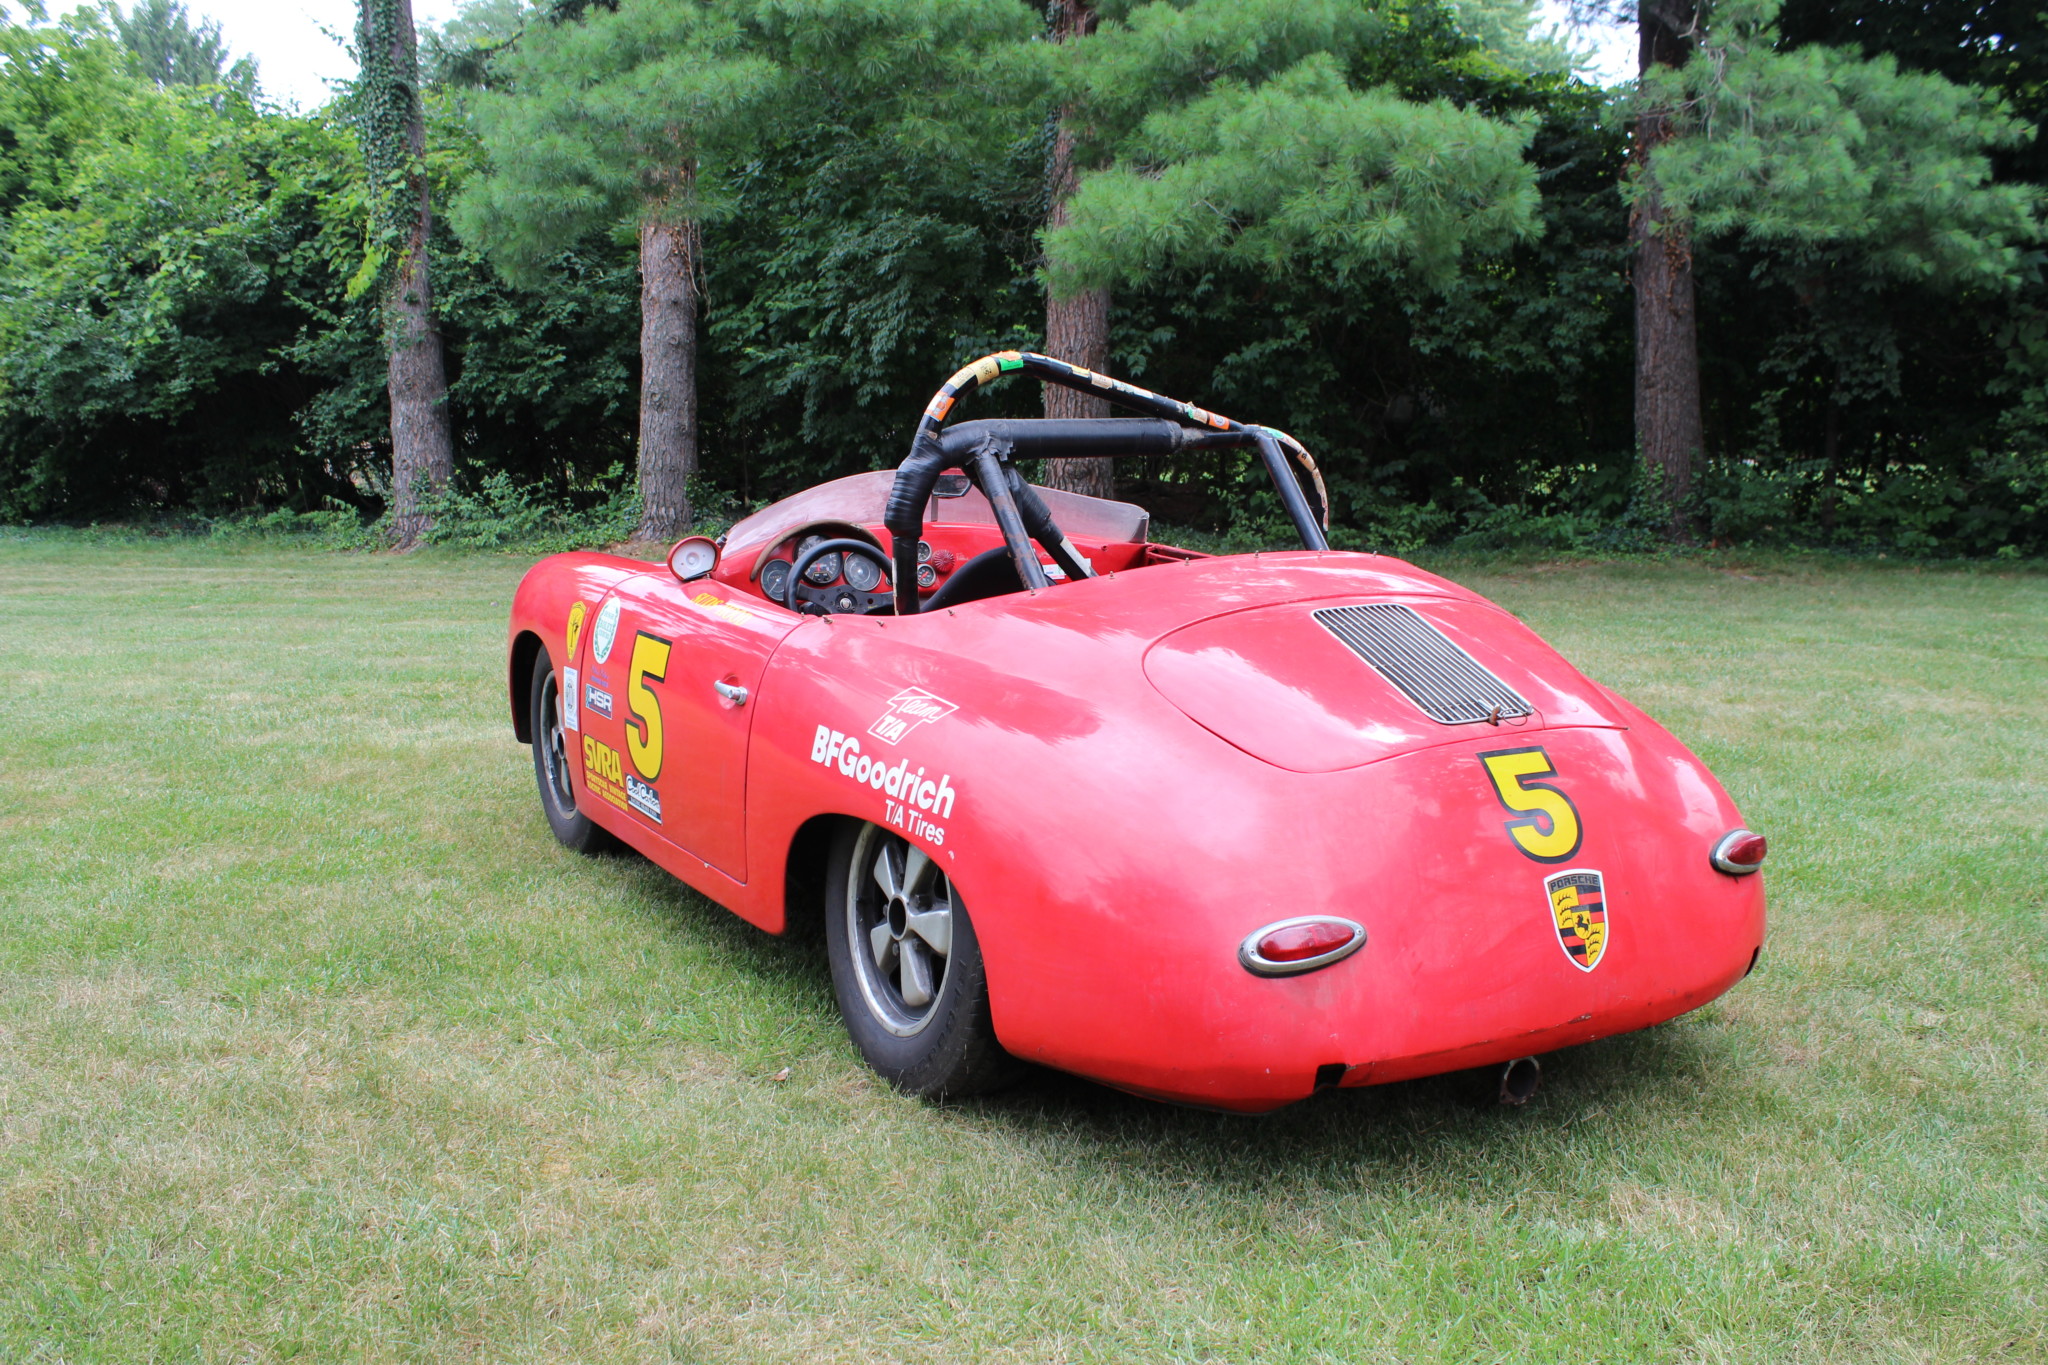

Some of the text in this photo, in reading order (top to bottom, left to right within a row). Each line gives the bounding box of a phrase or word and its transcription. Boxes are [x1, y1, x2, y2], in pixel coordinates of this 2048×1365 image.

[588, 687, 612, 712] HSR
[626, 630, 673, 784] 5
[894, 695, 942, 720] Team
[875, 715, 907, 741] T/A
[583, 733, 625, 789] SVRA
[811, 724, 955, 820] BFGoodrich
[885, 799, 945, 846] T/A Tires
[1476, 745, 1584, 864] 5
[1550, 874, 1599, 892] PORSCHE
